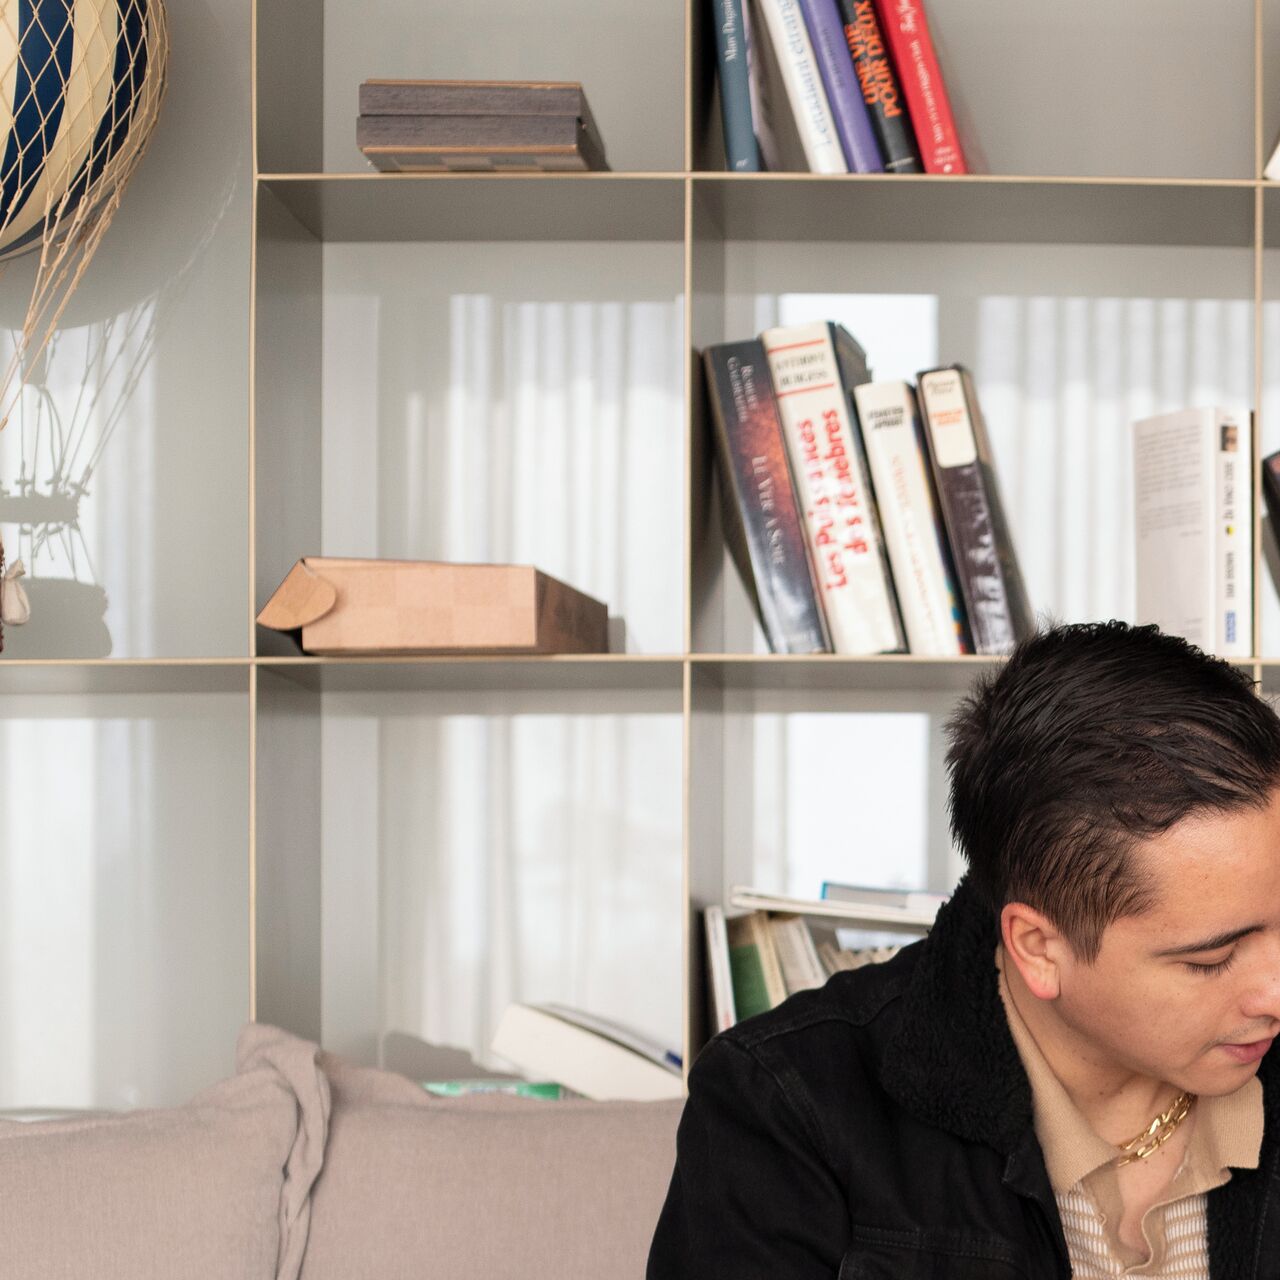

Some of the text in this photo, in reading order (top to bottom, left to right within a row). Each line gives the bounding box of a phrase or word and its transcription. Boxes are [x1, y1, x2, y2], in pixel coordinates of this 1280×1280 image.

[844, 24, 878, 104] UNE VIE
[855, 0, 902, 118] POUR DEUX
[741, 365, 760, 409] ROBERT
[752, 456, 768, 476] LE
[758, 477, 779, 512] VER
[766, 529, 787, 565] SOIE
[826, 551, 848, 590] Les
